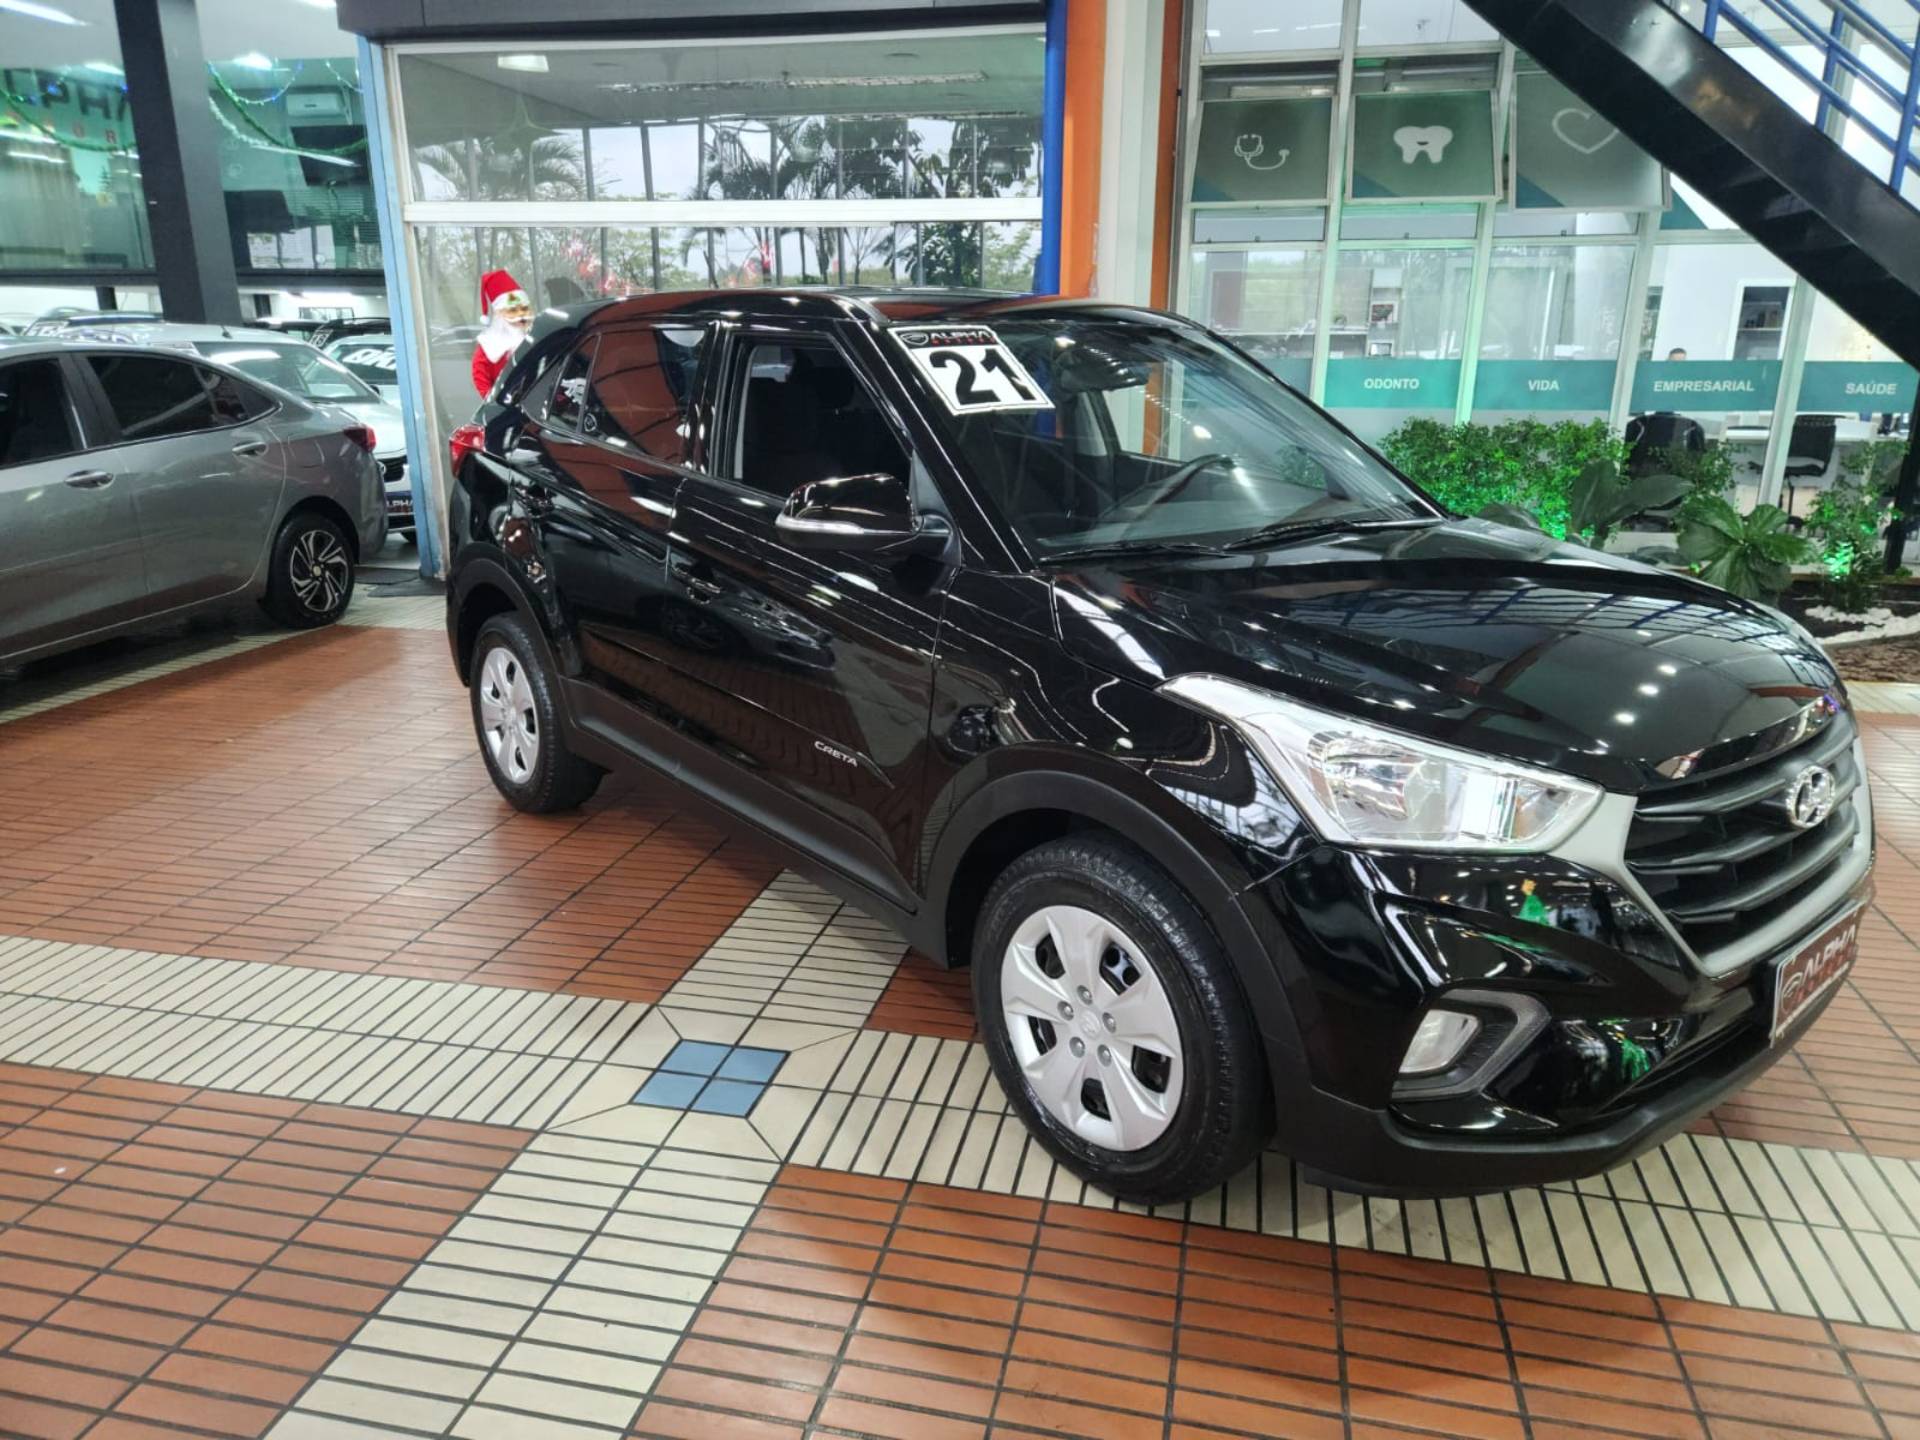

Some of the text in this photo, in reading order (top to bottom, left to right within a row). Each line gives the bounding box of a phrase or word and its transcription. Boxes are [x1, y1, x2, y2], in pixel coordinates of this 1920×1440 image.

[930, 348, 1037, 406] 21
[1364, 377, 1420, 390] ODONTO
[1528, 378, 1560, 392] VIDA
[1653, 379, 1755, 393] EMPRESARIAL
[1844, 379, 1897, 395] SAÚDE
[814, 740, 858, 767] CRETA
[1800, 924, 1857, 986] ALPHA
